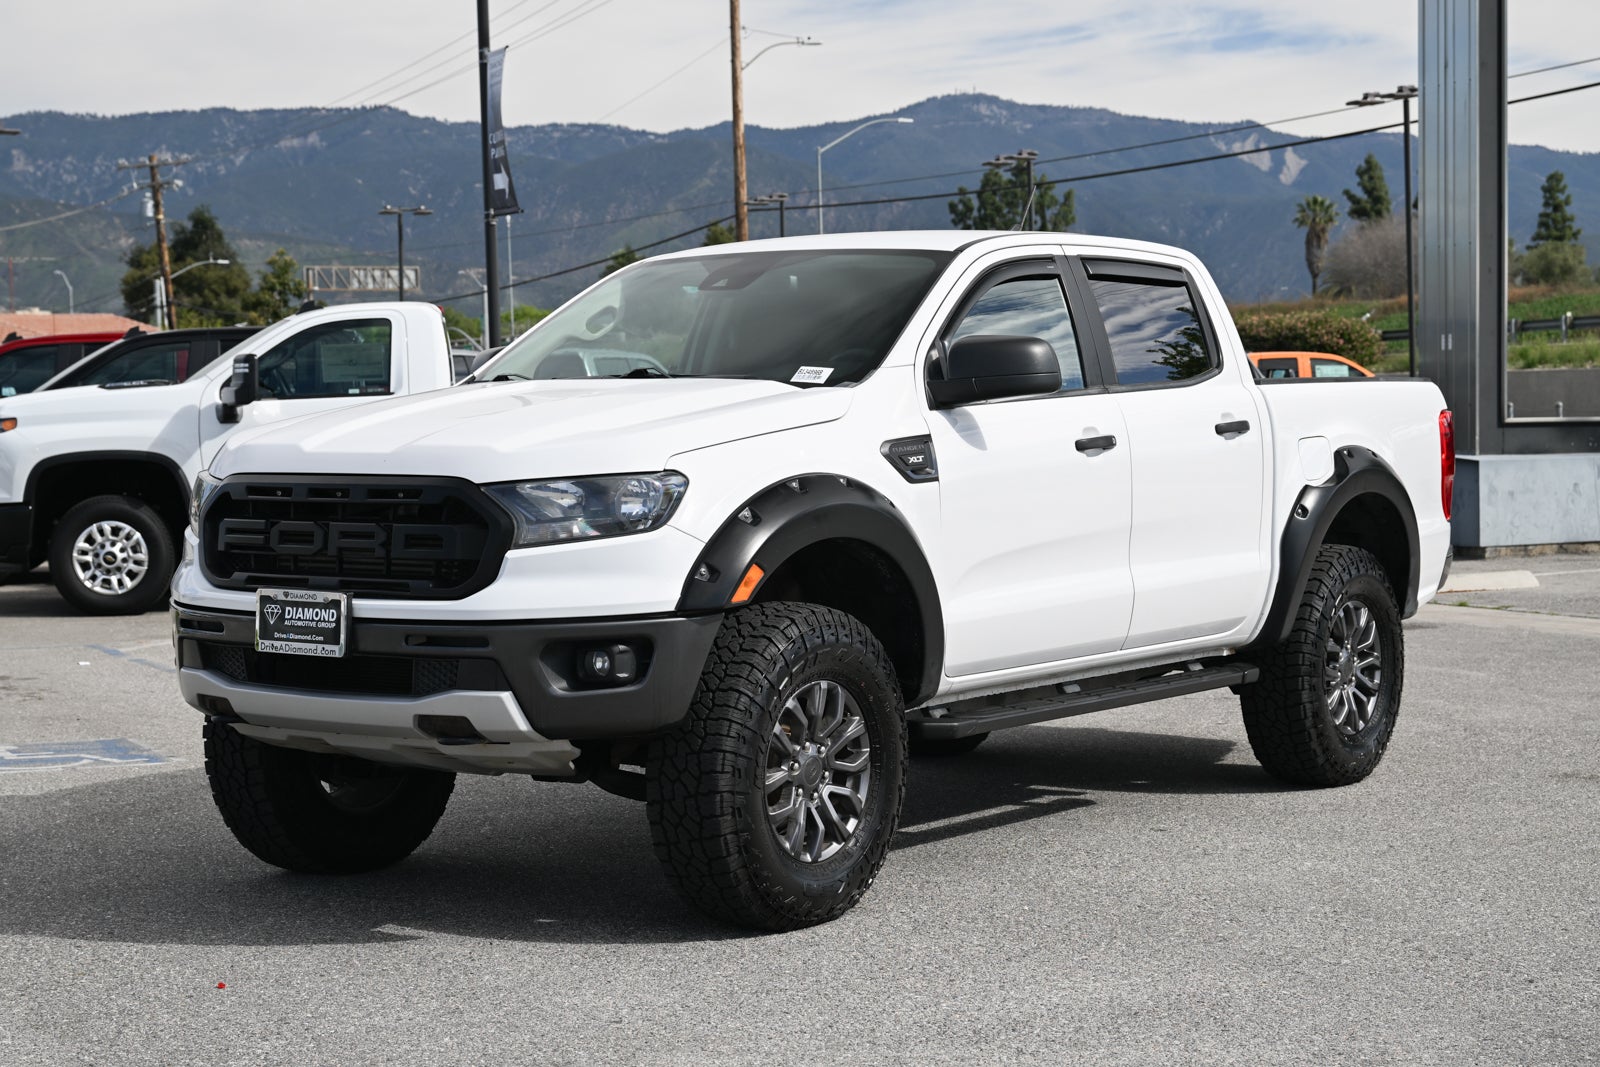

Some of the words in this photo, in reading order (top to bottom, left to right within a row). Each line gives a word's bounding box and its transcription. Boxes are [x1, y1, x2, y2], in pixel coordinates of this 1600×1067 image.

[907, 455, 924, 463] XLT
[218, 518, 459, 559] FORD
[285, 606, 337, 621] DIAMOND
[260, 643, 337, 656] DriveADiamond.com
